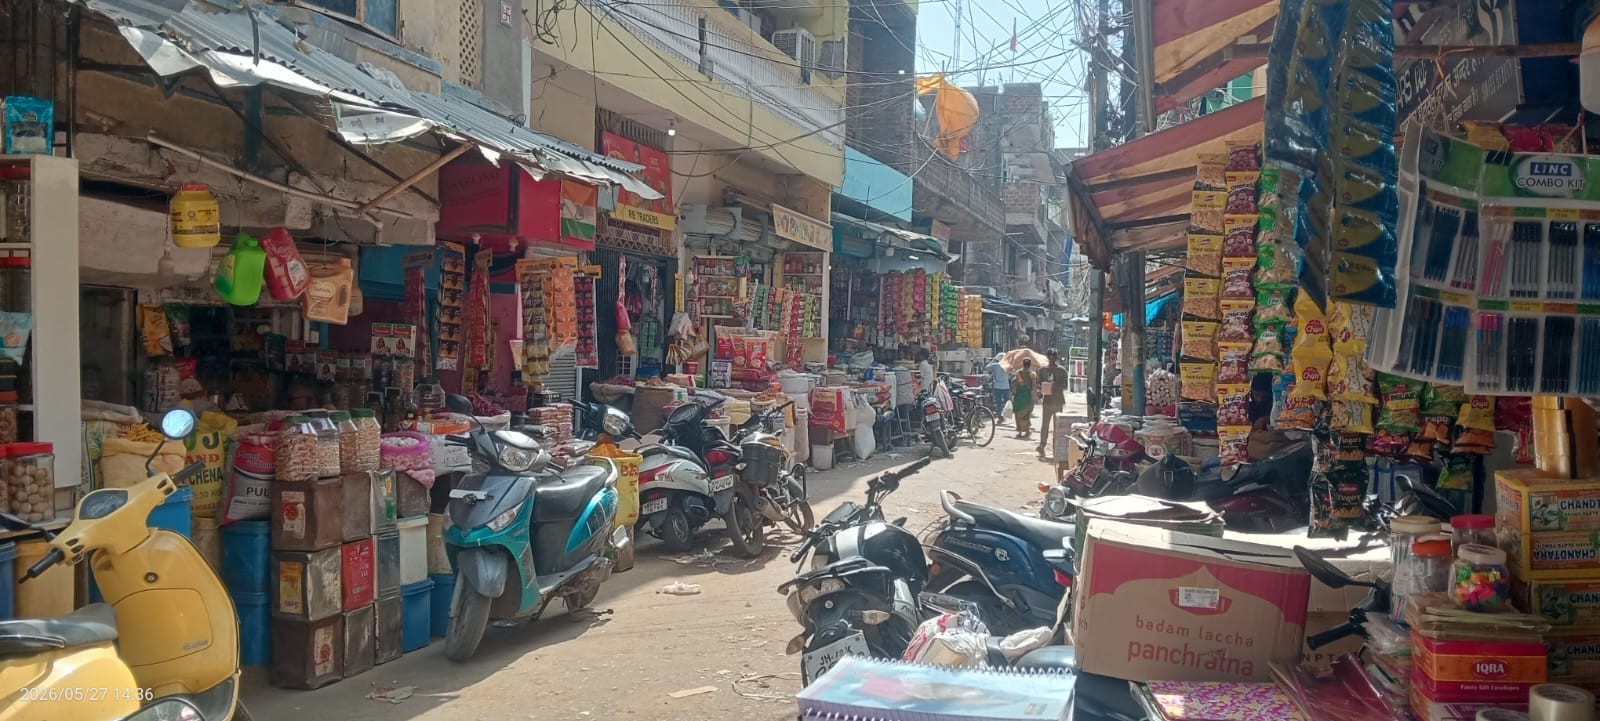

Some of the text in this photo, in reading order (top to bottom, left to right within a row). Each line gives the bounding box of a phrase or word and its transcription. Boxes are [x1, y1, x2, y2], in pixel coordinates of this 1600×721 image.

[1533, 164, 1569, 175] LINC
[1516, 177, 1585, 188] COMBO KIT
[185, 454, 220, 464] AND
[246, 487, 272, 497] PUL
[1535, 549, 1596, 560] CHANDTARA
[1570, 593, 1600, 604] CHAN
[1136, 615, 1254, 648] badam laccha
[1476, 663, 1505, 674] IQRA
